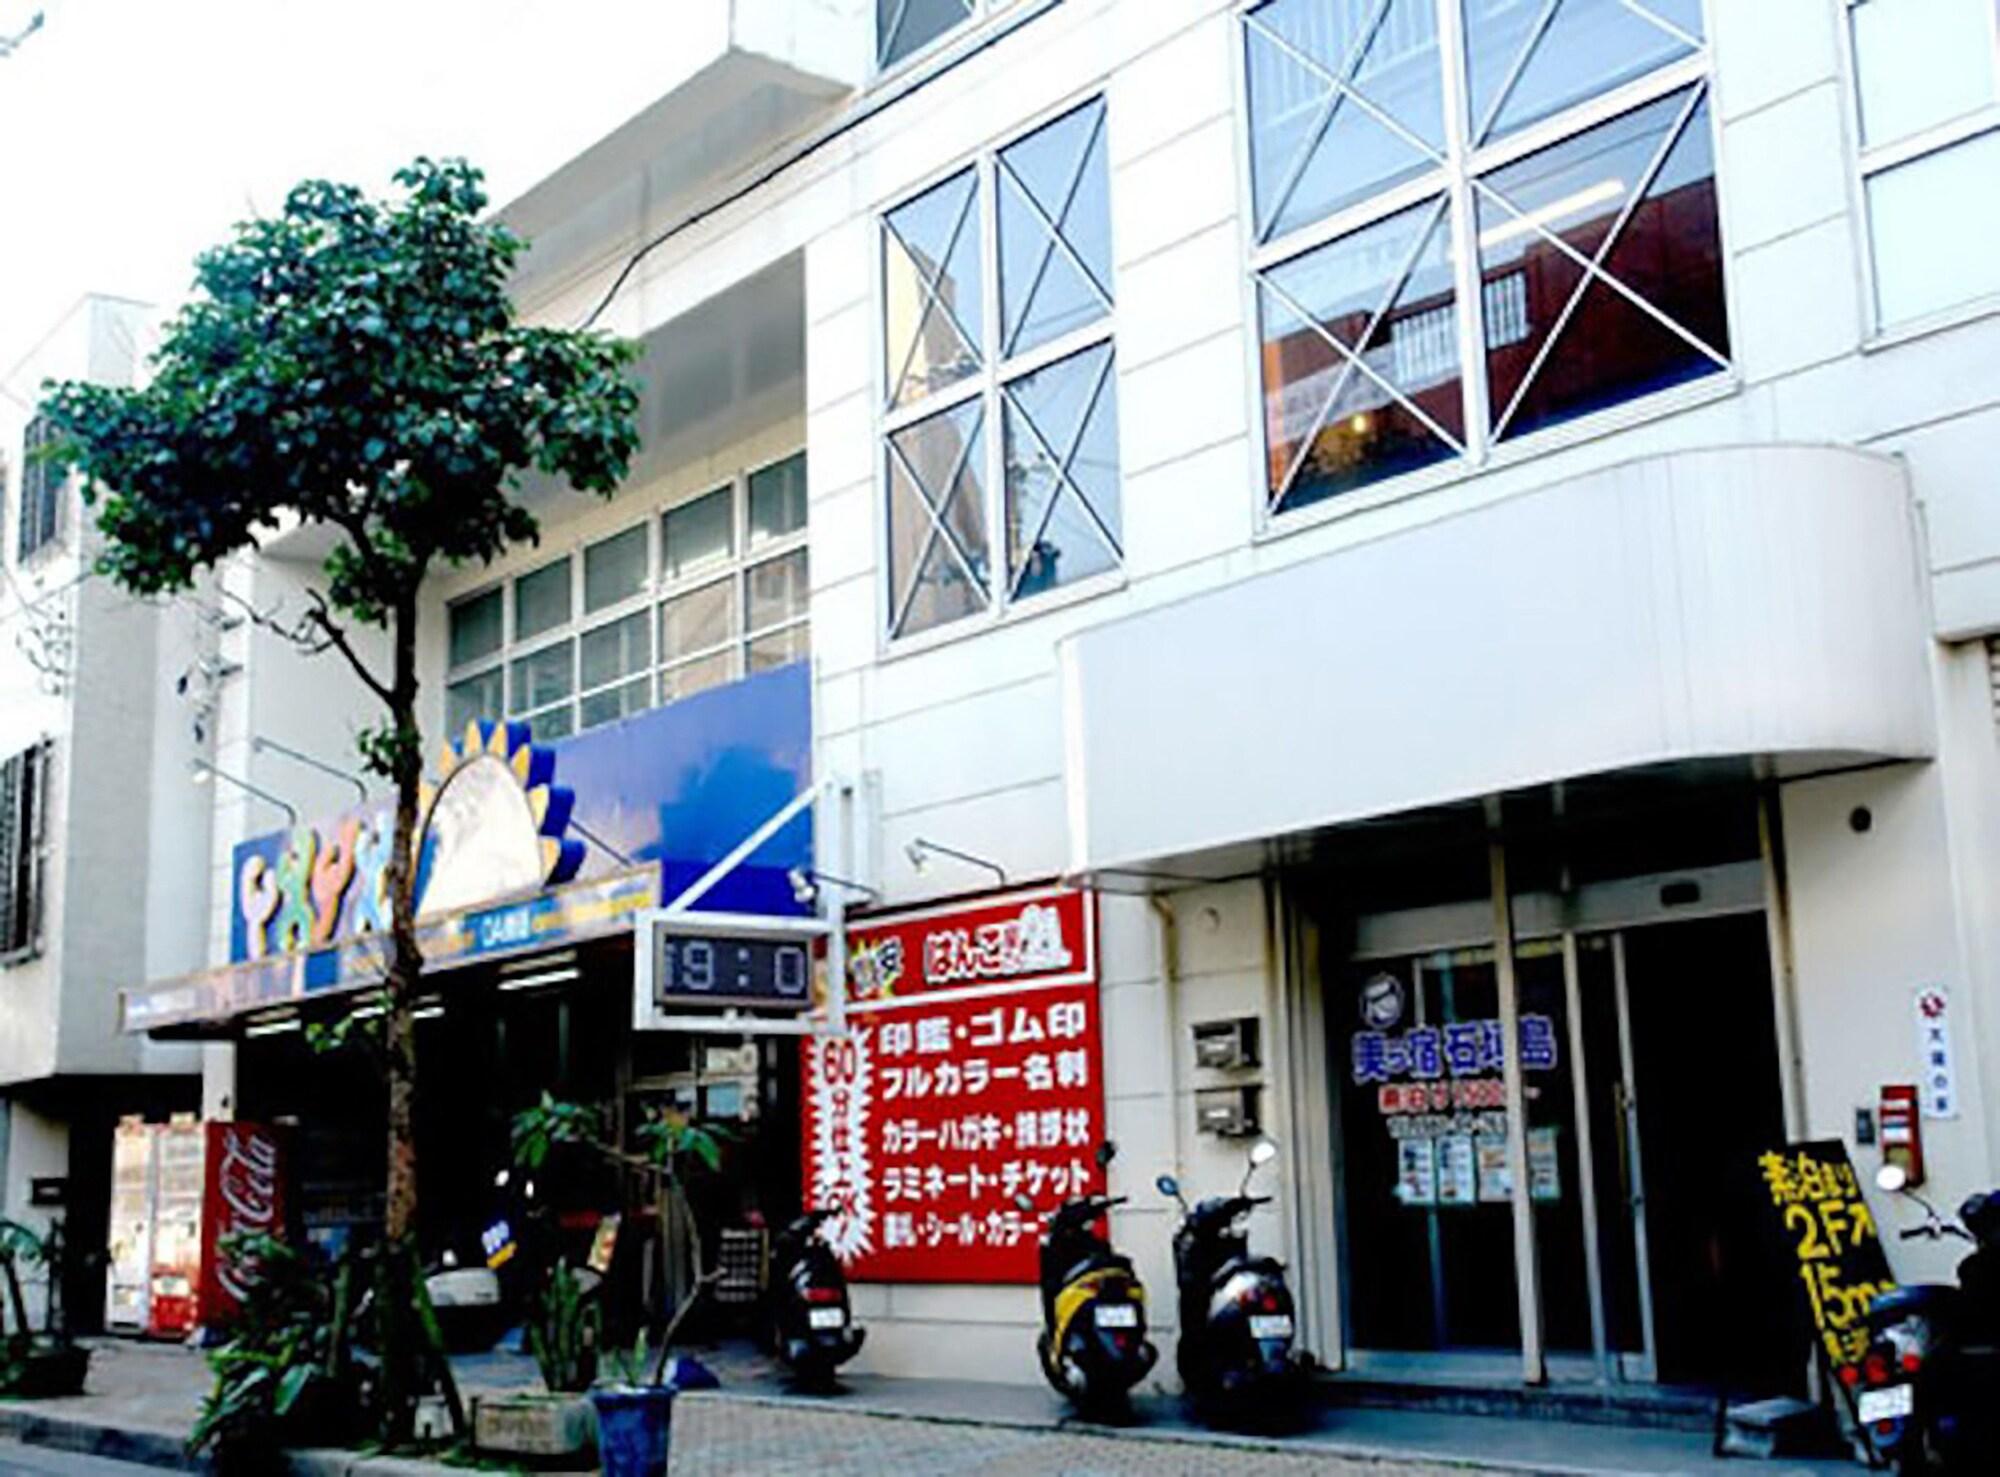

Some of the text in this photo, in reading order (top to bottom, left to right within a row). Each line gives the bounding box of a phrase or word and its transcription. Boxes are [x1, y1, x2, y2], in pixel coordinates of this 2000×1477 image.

[880, 1003, 1086, 1055] 印鑑・ゴム印
[881, 1050, 1088, 1098] フルカラー名刺
[882, 1158, 1090, 1200] ラミネート・チケット
